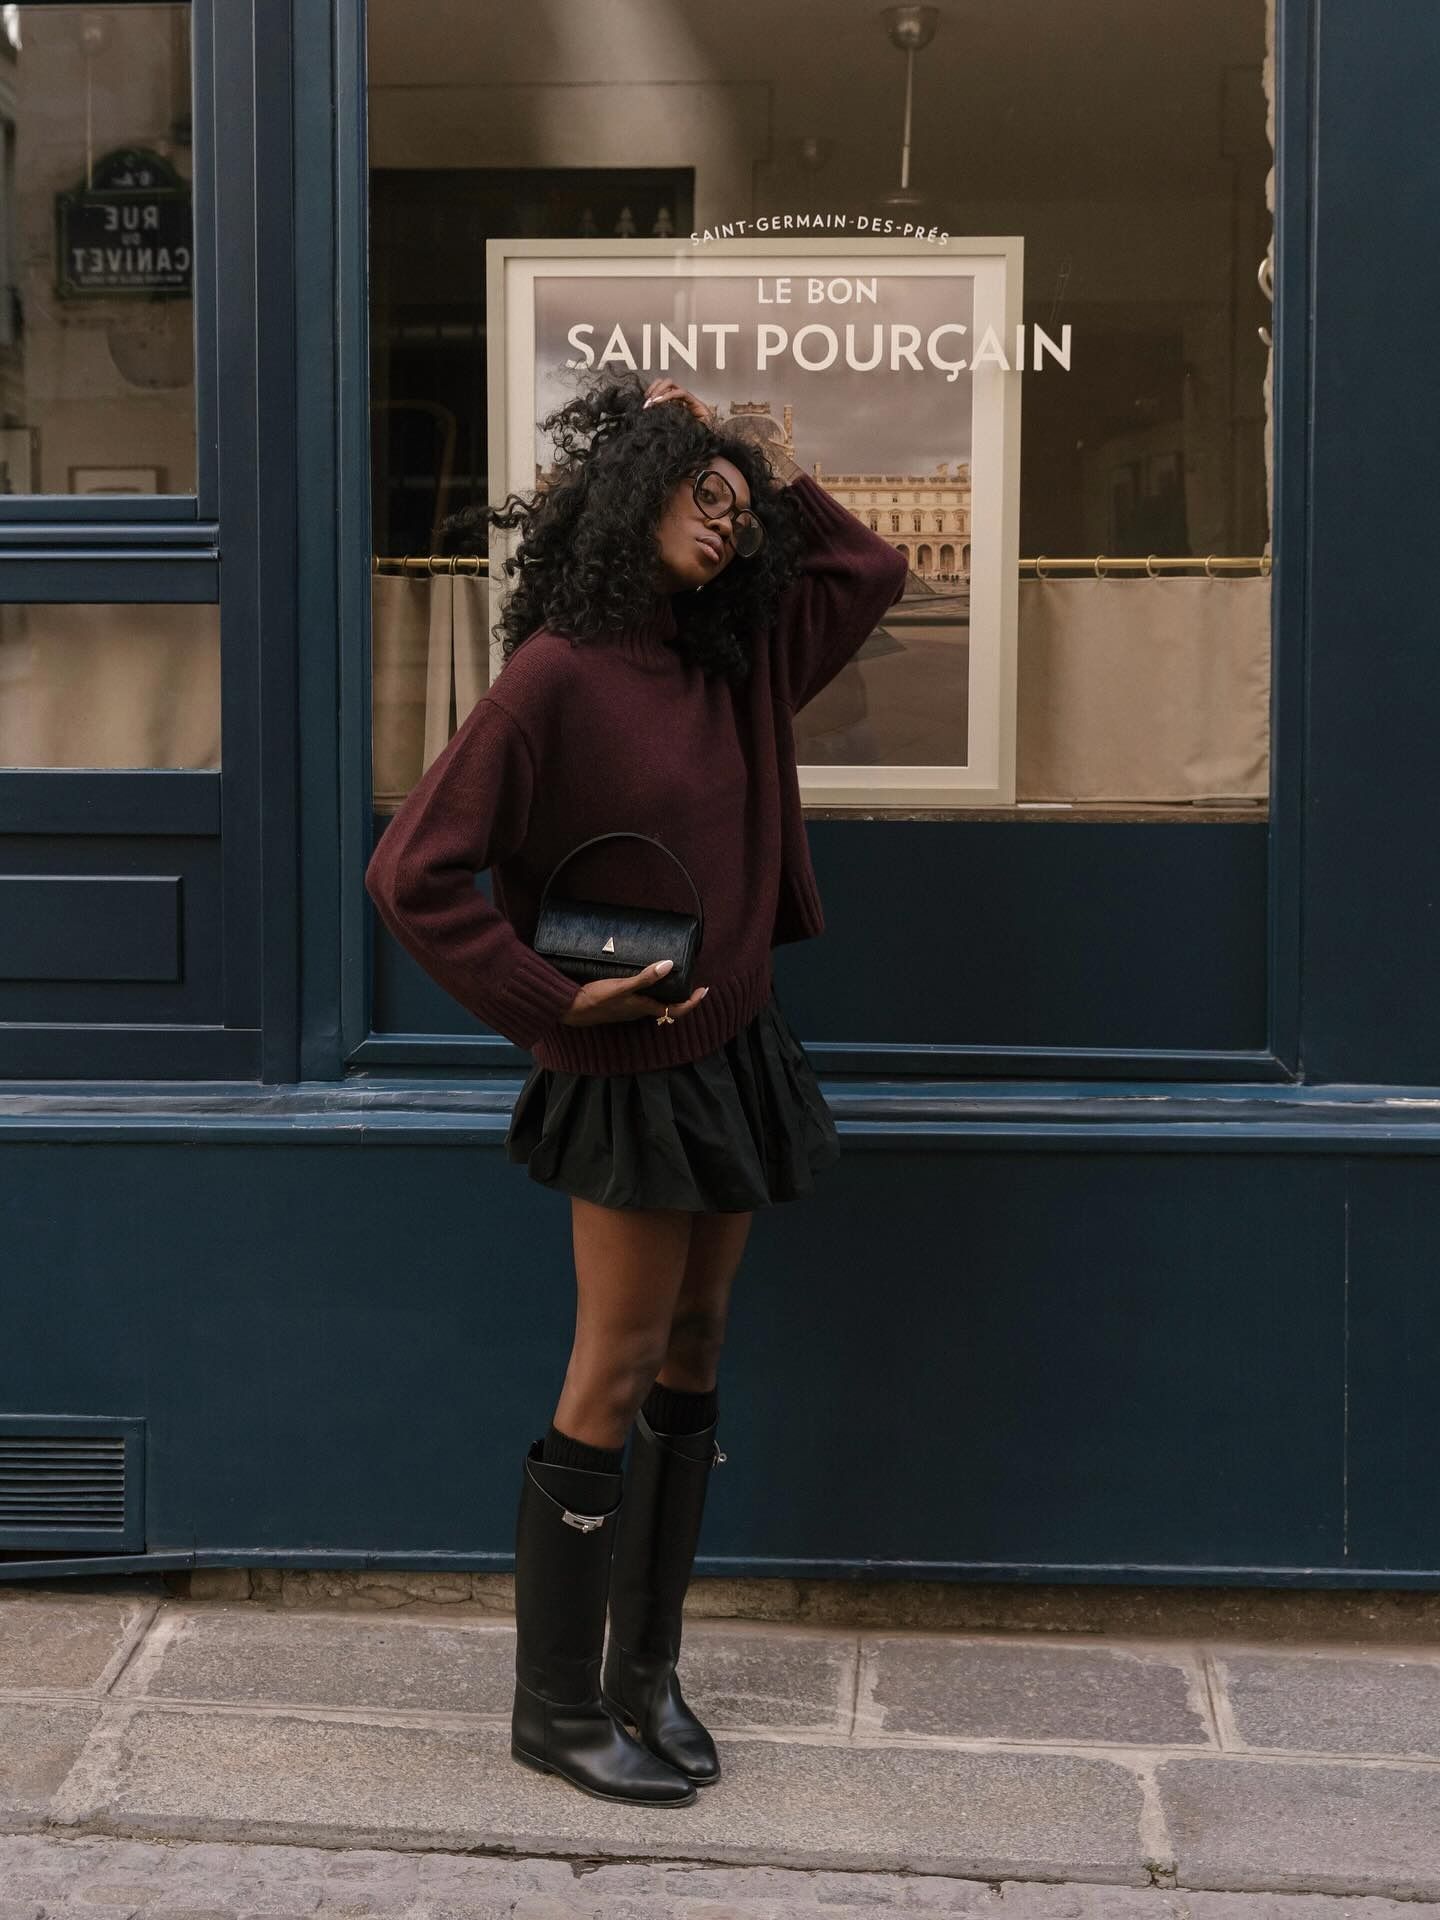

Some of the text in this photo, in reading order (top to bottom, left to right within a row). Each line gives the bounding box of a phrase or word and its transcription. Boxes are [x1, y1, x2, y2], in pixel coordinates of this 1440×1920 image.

[690, 214, 949, 246] SAINT-GERMAIN-DES-PRÉS
[758, 278, 878, 304] LE BON
[565, 323, 1072, 382] SAINT POURÇAIN
